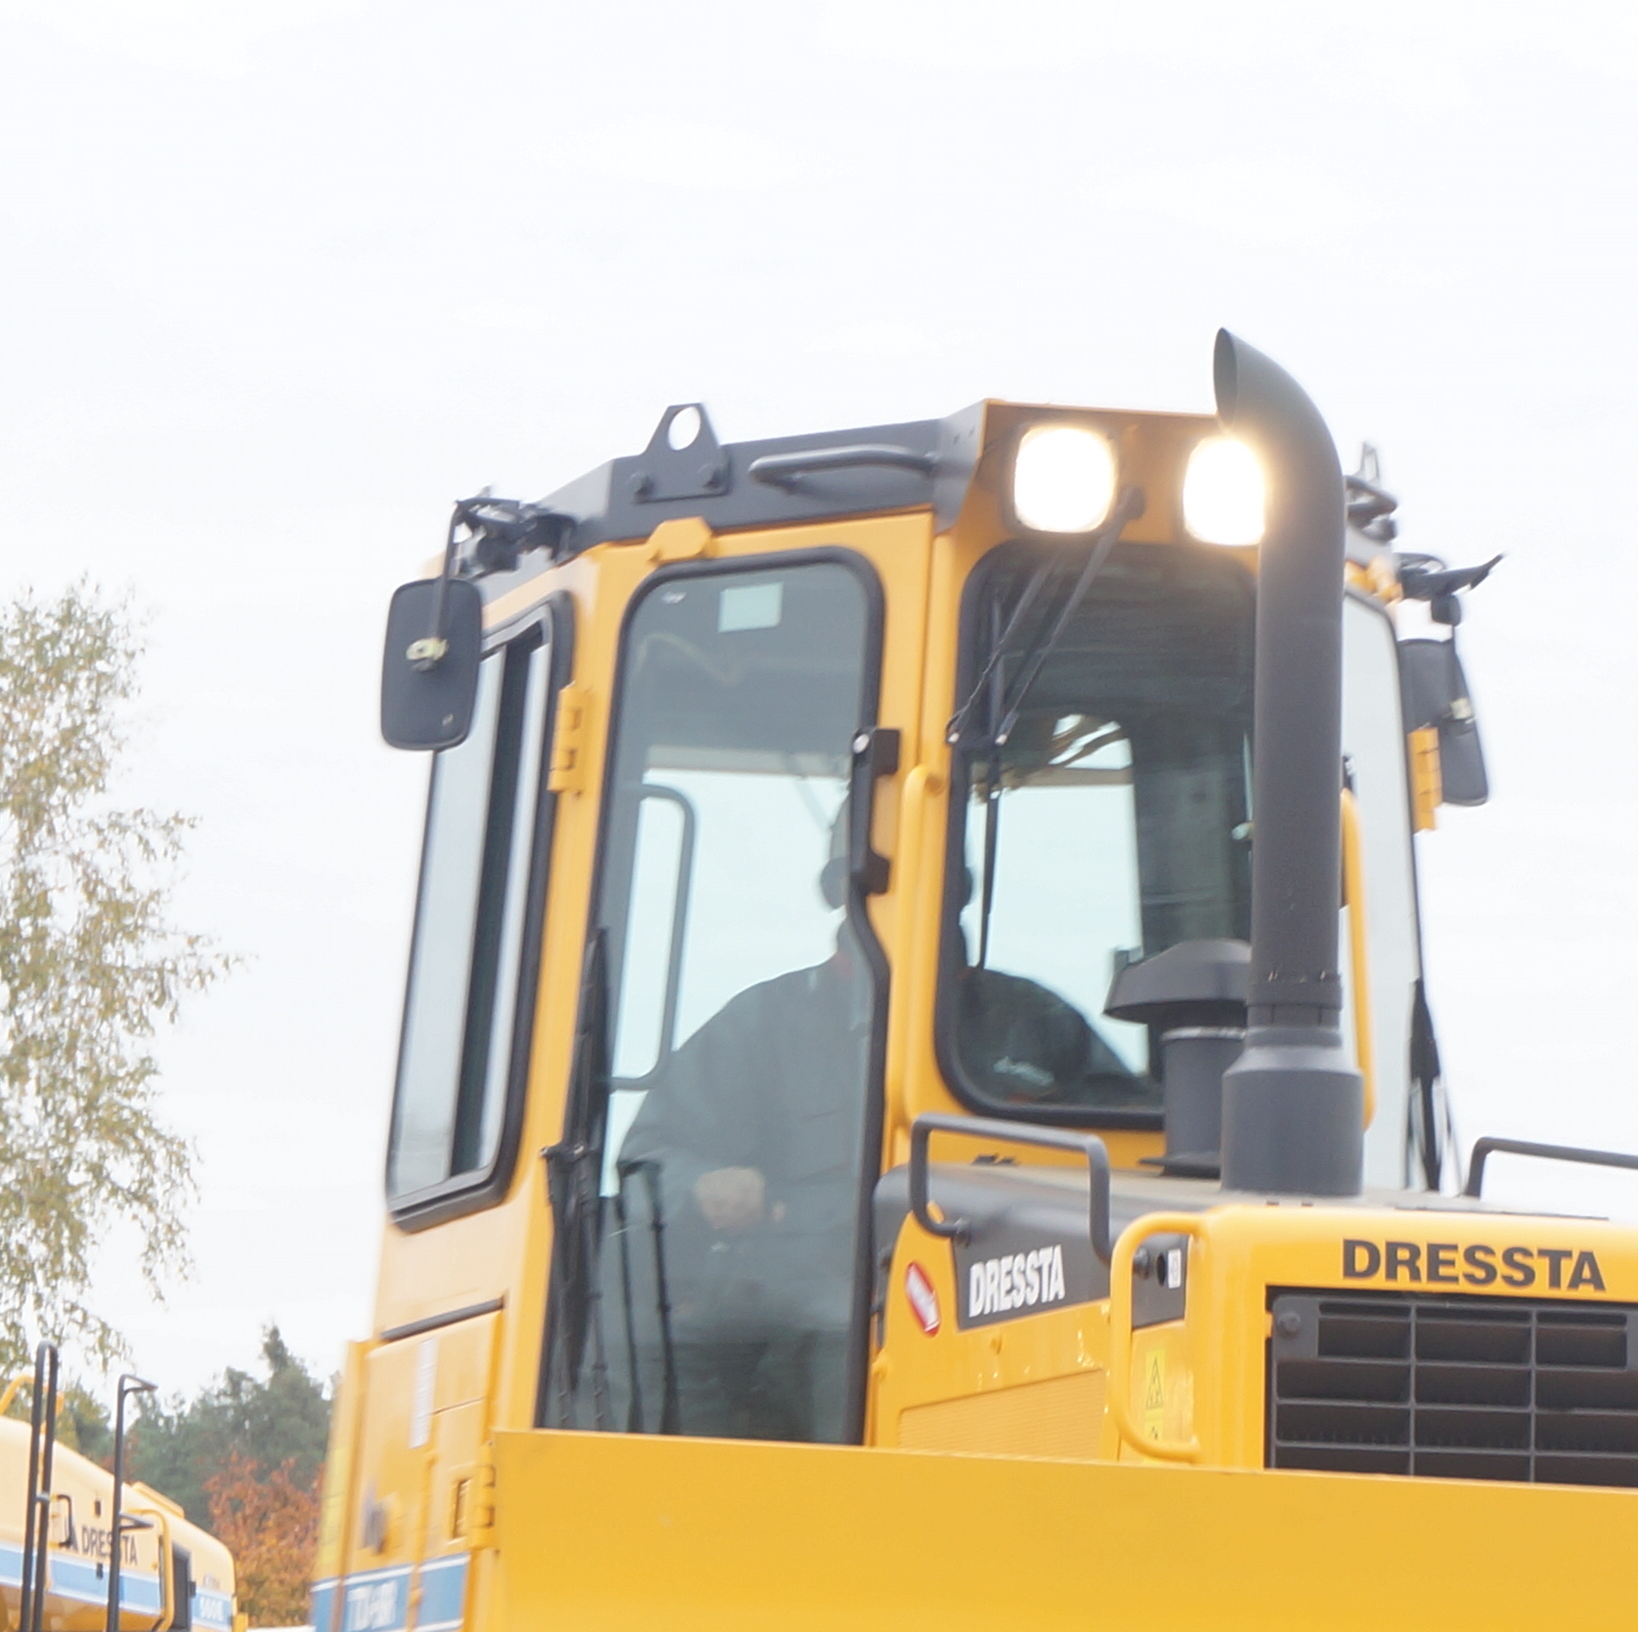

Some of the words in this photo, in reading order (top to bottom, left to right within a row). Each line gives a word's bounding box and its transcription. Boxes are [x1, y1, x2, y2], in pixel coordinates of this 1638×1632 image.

[968, 1244, 1066, 1318] DRESSTA
[1342, 1238, 1606, 1292] DRESSTA
[81, 1525, 138, 1566] DRESTA
